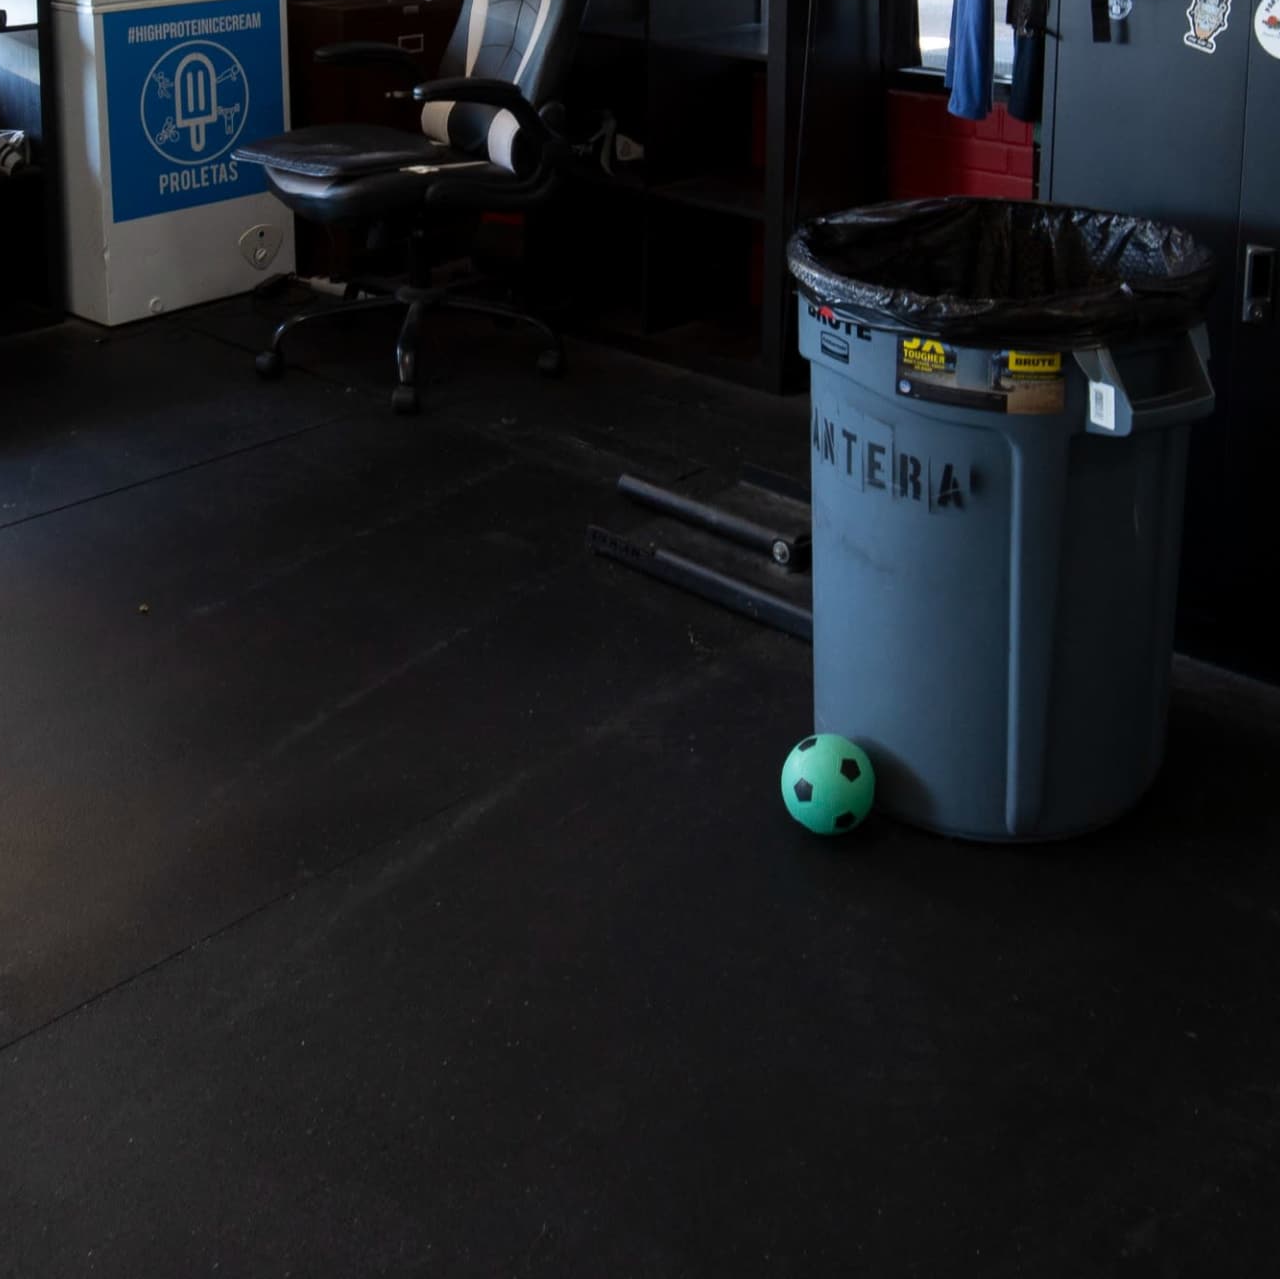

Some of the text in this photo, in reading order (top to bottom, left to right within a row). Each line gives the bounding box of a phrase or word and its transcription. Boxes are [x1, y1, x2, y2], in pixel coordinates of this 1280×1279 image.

[128, 12, 262, 44] #HIGHPROTEINICECREAM
[159, 161, 238, 195] PROLETAS
[903, 349, 946, 364] TOUGHER
[1014, 357, 1055, 367] BRUTE
[811, 407, 965, 511] ANTERA
